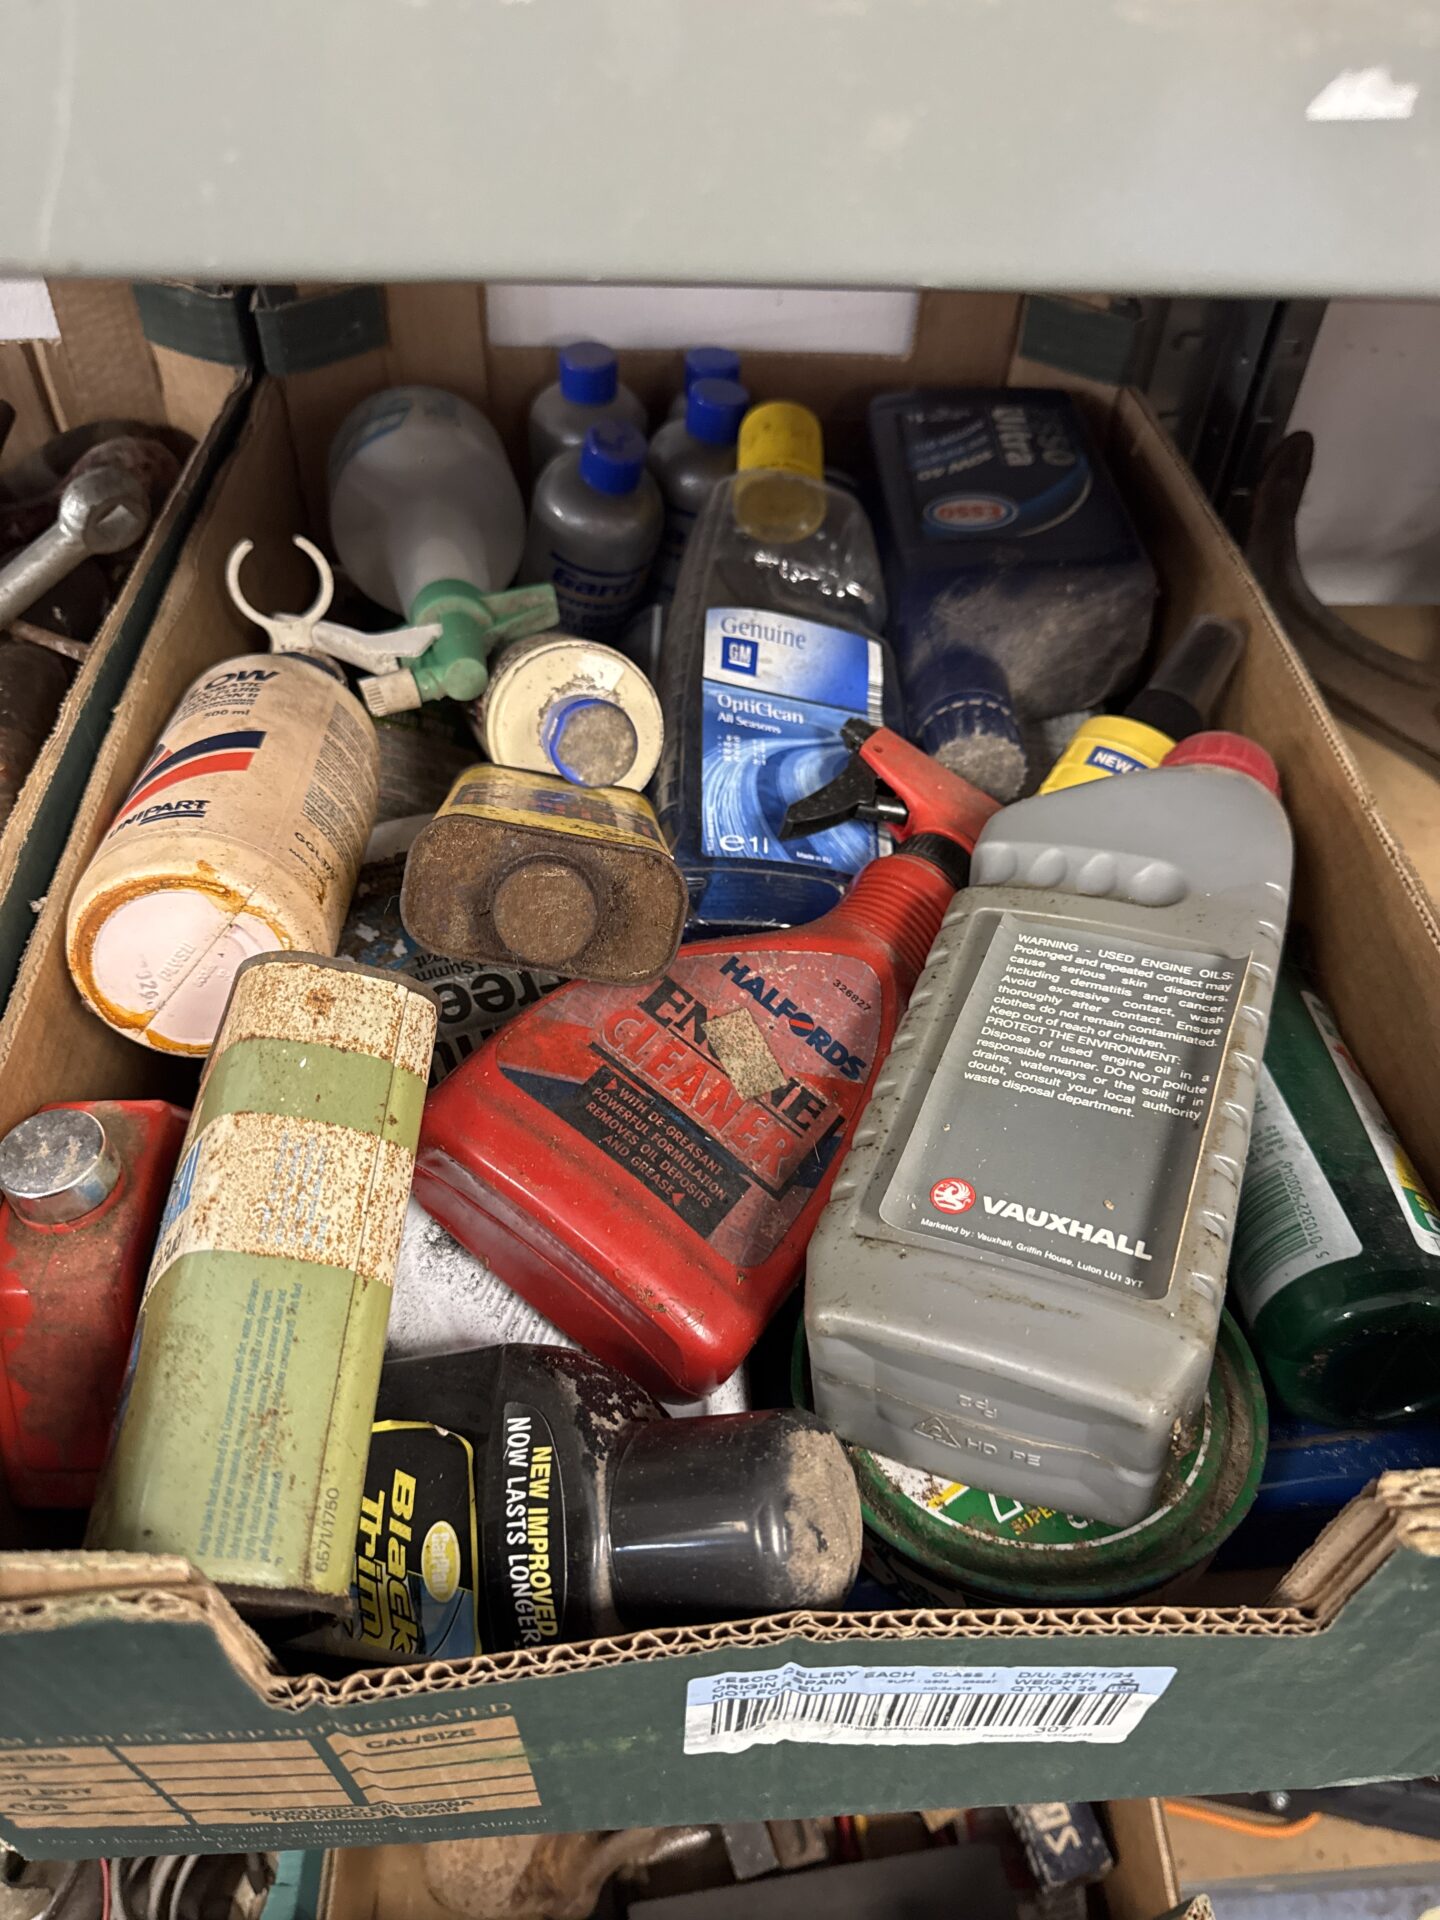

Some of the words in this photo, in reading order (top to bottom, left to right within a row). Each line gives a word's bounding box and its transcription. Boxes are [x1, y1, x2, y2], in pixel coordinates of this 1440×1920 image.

[720, 616, 807, 650] Genuine
[729, 642, 751, 662] GM
[717, 694, 804, 724] OptiClean
[717, 712, 734, 724] All
[735, 716, 782, 735] Seasons
[107, 800, 211, 840] UNIPART
[1010, 956, 1046, 968] cause
[1061, 964, 1106, 980] serious
[1121, 976, 1147, 988] skin
[1014, 944, 1072, 963] Prolonged
[1075, 952, 1098, 968] and
[1100, 962, 1153, 979] repeated
[1156, 973, 1203, 989] contact
[1206, 981, 1231, 992] may
[1018, 934, 1079, 952] WARNING
[1098, 949, 1135, 964] USED
[1141, 959, 1193, 975] ENGINE
[833, 979, 871, 1011] 326827
[1001, 975, 1036, 988] Avoid
[1049, 985, 1110, 1003] excessive
[1190, 1013, 1224, 1024] wash
[1006, 964, 1060, 983] including
[1070, 977, 1132, 997] dermatitis
[1143, 991, 1167, 1003] and
[719, 956, 867, 1081] HALFORDS
[985, 1015, 1046, 1035] PROTECT
[1050, 1029, 1075, 1042] THE
[989, 1005, 1019, 1021] Keep
[1023, 1011, 1043, 1023] out
[1046, 1015, 1059, 1026] of
[1061, 1019, 1095, 1035] reach
[1098, 1027, 1111, 1037] of
[994, 995, 1037, 1012] clothes
[1040, 1003, 1056, 1014] do
[1059, 1009, 1079, 1020] not
[1083, 1014, 1125, 1029] remain
[998, 985, 1062, 1006] thoroughly
[1072, 999, 1102, 1013] after
[1176, 1021, 1221, 1036] Ensure
[977, 1038, 1046, 1059] responsible
[1104, 1065, 1126, 1076] DO
[1129, 1071, 1161, 1085] NOT
[1163, 1078, 1207, 1094] pollute
[981, 1027, 1030, 1045] Dispose
[1039, 1038, 1053, 1049] of
[1061, 1044, 1092, 1057] used
[1101, 1054, 1145, 1069] engine
[1155, 1063, 1170, 1075] oil
[1180, 1070, 1192, 1080] in
[1201, 1074, 1210, 1082] a
[601, 1009, 796, 1183] CLEANER
[964, 1072, 999, 1086] waste
[1002, 1078, 1054, 1099] disposal
[1014, 1070, 1061, 1087] consult
[1068, 1081, 1097, 1096] your
[1104, 1089, 1135, 1104] local
[1142, 1100, 1201, 1121] authority
[1020, 1058, 1086, 1081] waterways
[1093, 1075, 1108, 1084] or
[1114, 1078, 1135, 1091] the
[1176, 1094, 1186, 1104] If
[1193, 1096, 1204, 1106] in
[592, 1087, 650, 1135] POWERFUL
[651, 1132, 727, 1201] FORMULATION
[619, 1088, 648, 1113] WITH
[648, 1112, 723, 1175] DE-GREASANT
[586, 1101, 640, 1146] REMOVES
[640, 1144, 659, 1162] OIL
[659, 1160, 712, 1208] DEPOSITS
[603, 1135, 629, 1157] AND
[630, 1157, 675, 1195] GREASE
[1280, 1161, 1307, 1201] 500046
[983, 1196, 1152, 1261] VAUXHALL
[1296, 1202, 1324, 1245] 010322
[920, 1217, 958, 1233] Marketed
[977, 1231, 1014, 1249] Vauxhall,
[1016, 1242, 1042, 1257] Griffin
[1045, 1251, 1074, 1268] House,
[1077, 1260, 1101, 1275] Luton
[1104, 1269, 1122, 1282] LU1
[1125, 1277, 1144, 1289] 3YT
[507, 1416, 531, 1468] NOW
[967, 1437, 998, 1455] HD
[1011, 1450, 1041, 1467] PE
[527, 1446, 552, 1500] NEW
[315, 1487, 340, 1573] 6571/1750
[506, 1476, 527, 1546] LASTS
[1010, 1506, 1056, 1535] SUPE
[357, 1489, 386, 1650] Trim
[387, 1469, 417, 1654] Black
[527, 1507, 559, 1636] IMPROVED
[508, 1554, 541, 1643] LONGER
[712, 1690, 751, 1700] NOT
[713, 1674, 778, 1685] TESCO
[791, 1676, 847, 1686] SPAIN
[365, 1727, 477, 1749] CAL/SIZE
[1033, 1726, 1073, 1734] 307
[251, 1807, 364, 1817] PRODUCIDO
[270, 1810, 377, 1821] PRODUCED
[404, 1807, 460, 1816] SPAIN
